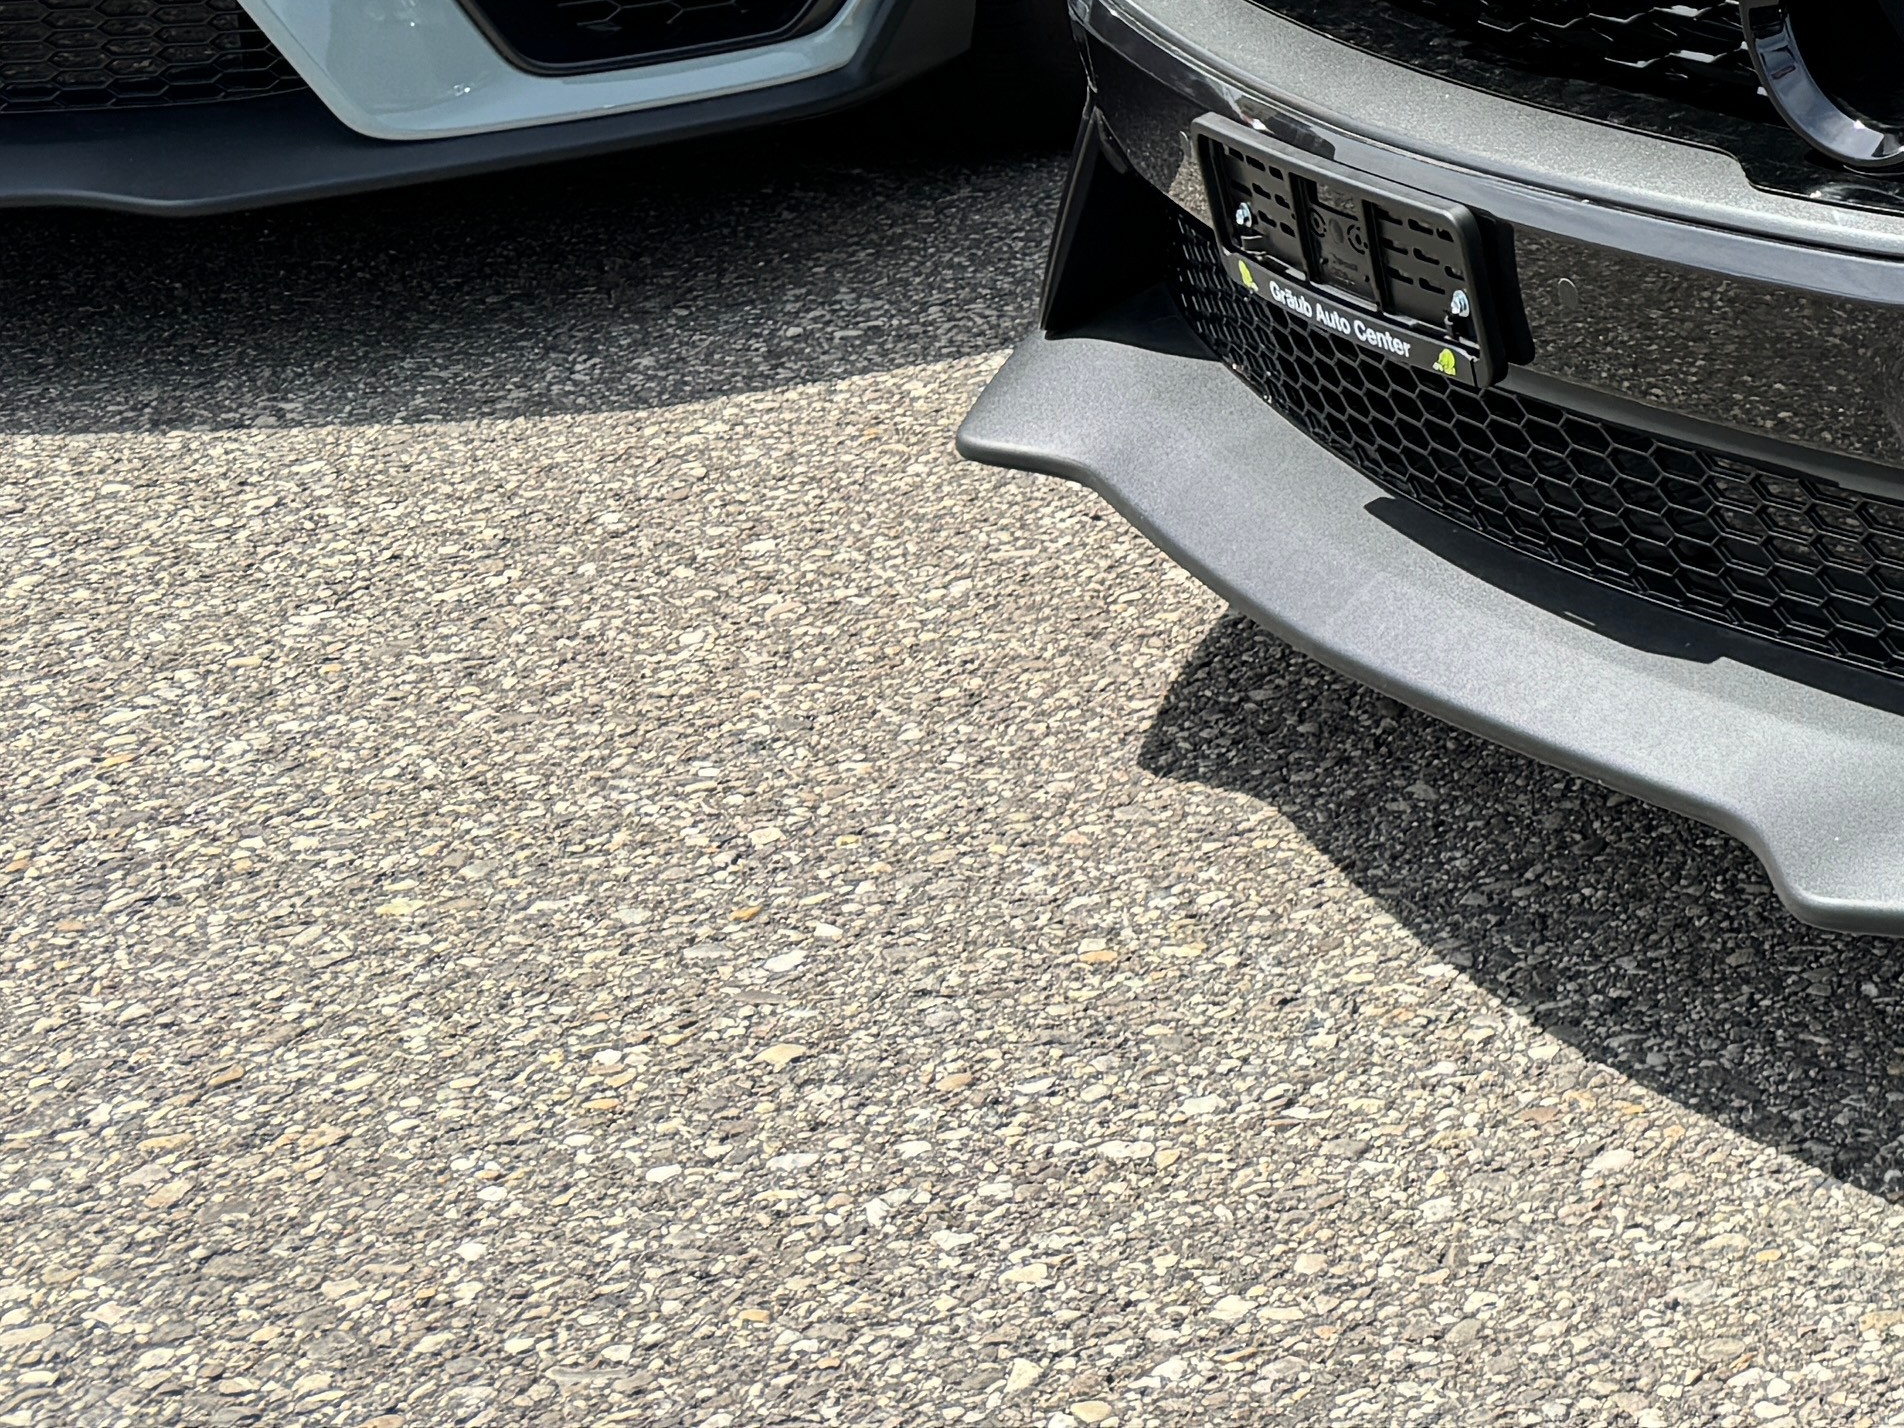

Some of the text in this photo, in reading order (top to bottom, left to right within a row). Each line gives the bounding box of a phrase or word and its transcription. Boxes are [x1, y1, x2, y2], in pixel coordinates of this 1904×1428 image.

[1269, 280, 1412, 358] Gräub Auto Center
